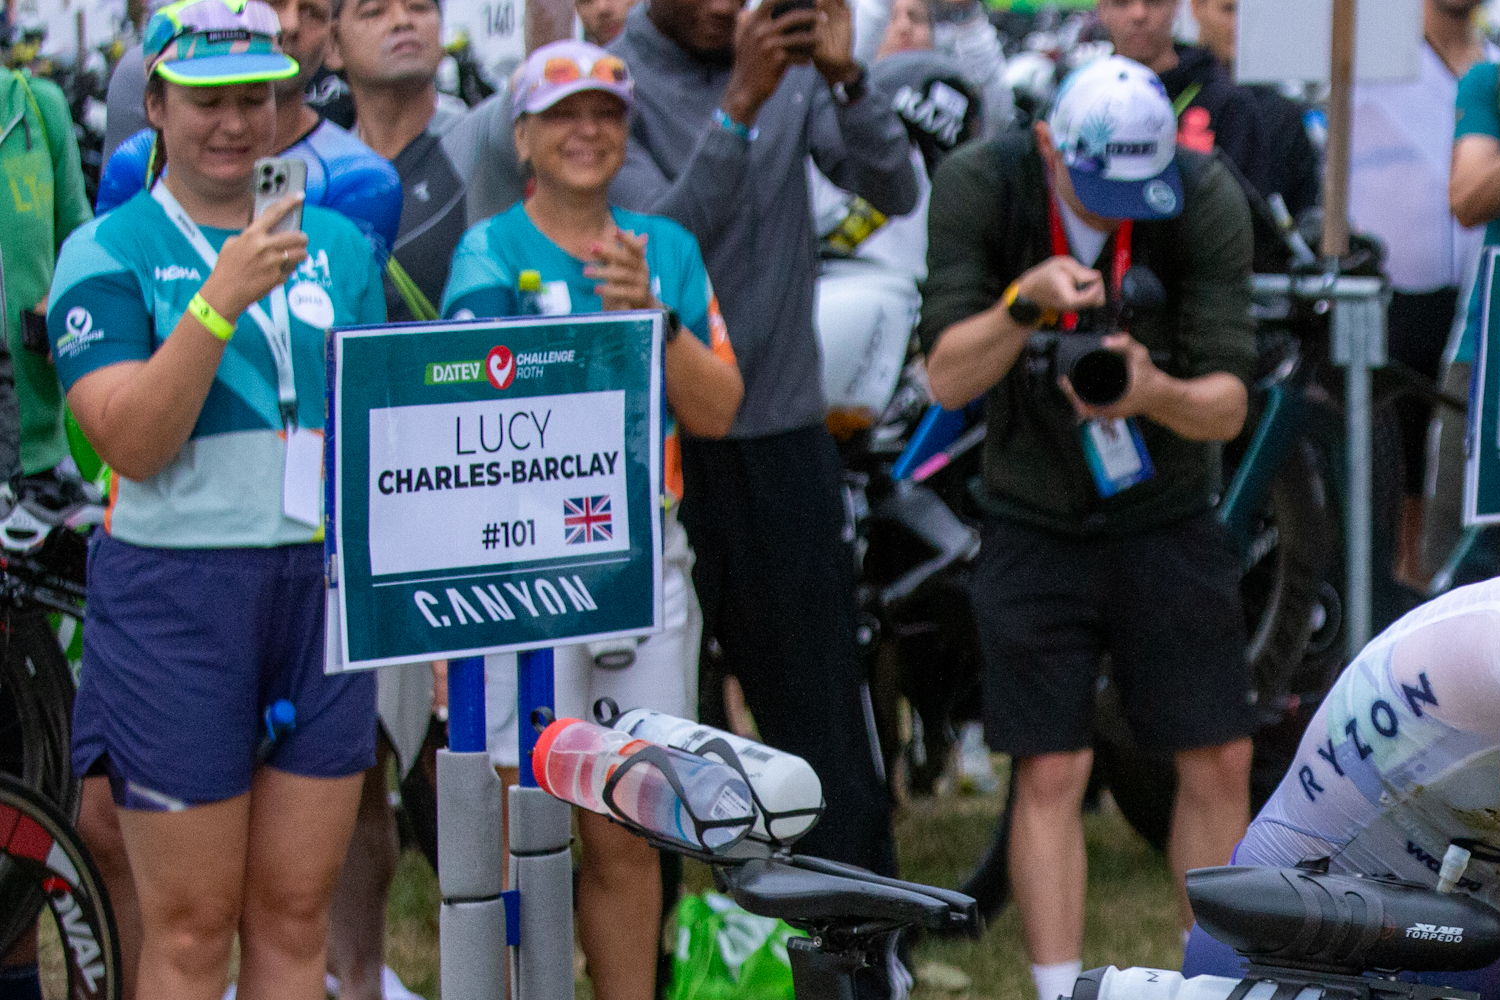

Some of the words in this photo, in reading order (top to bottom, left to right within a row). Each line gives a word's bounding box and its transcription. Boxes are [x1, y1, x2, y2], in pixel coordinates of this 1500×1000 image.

[516, 350, 576, 366] CHALLENGE
[432, 362, 481, 384] DATEV
[516, 366, 544, 380] ROTH
[456, 409, 551, 456] LUCY
[377, 451, 619, 496] CHARLES-BARCLAY
[481, 519, 537, 550] #101
[413, 574, 599, 629] CANYON
[1299, 671, 1440, 803] RYZON
[1405, 929, 1463, 943] TORPEDO
[1406, 922, 1464, 937] XLAB
